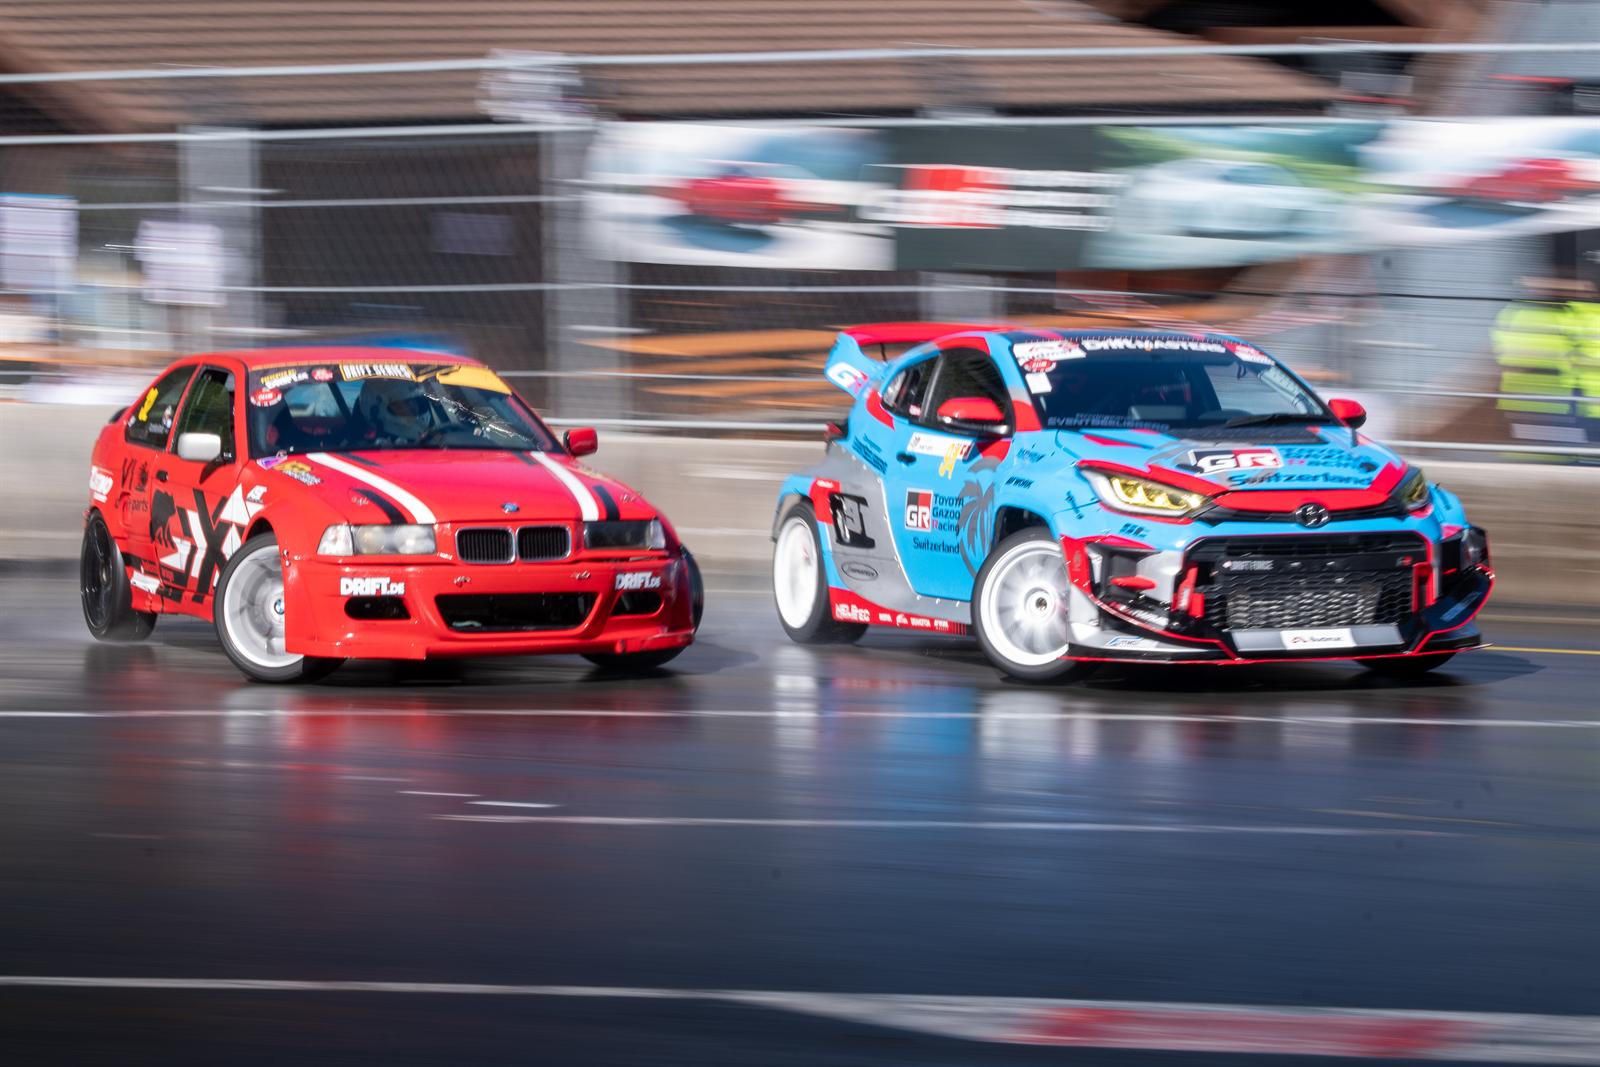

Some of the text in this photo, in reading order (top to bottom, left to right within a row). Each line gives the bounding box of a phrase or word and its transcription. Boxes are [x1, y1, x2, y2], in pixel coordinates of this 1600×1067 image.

[1197, 453, 1279, 473] GR
[1226, 470, 1374, 487] Switzerland
[934, 493, 964, 508] TOYOTA
[905, 504, 931, 530] GR
[932, 506, 961, 520] GAZOO
[932, 518, 960, 537] Racing
[912, 536, 960, 554] Switzerland
